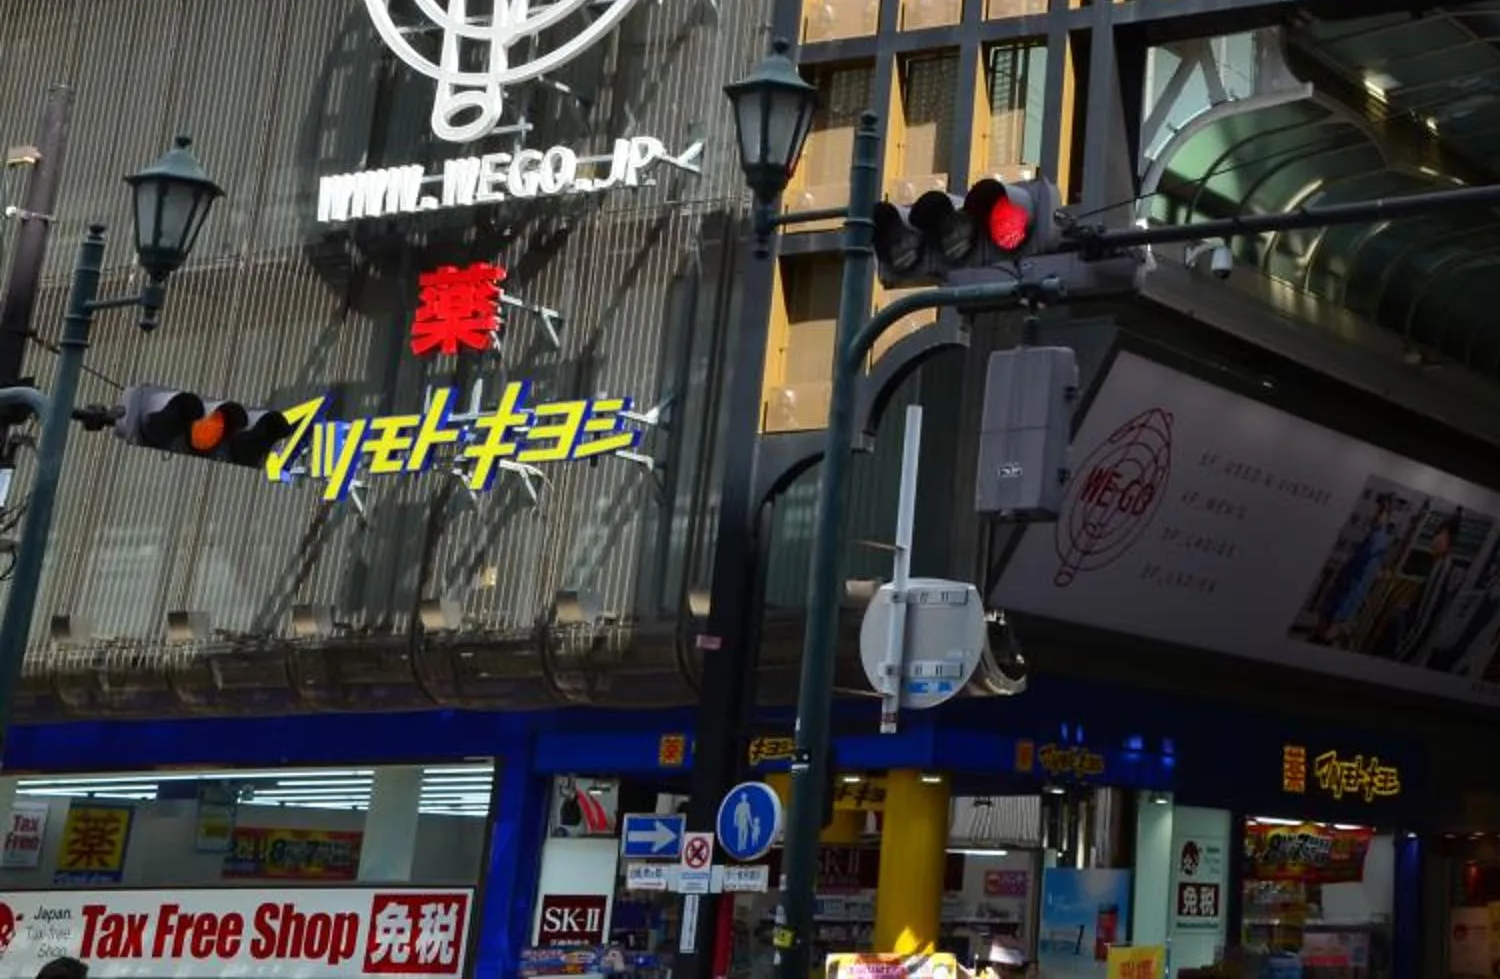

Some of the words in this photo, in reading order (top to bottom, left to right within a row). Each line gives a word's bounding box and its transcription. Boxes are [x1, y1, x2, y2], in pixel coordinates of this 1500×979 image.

[410, 262, 506, 357] 薬
[267, 381, 639, 501] マツモトキヨシ
[78, 904, 149, 959] Tax
[151, 903, 243, 959] Free
[249, 902, 361, 965] Shop
[369, 901, 460, 965] 免税
